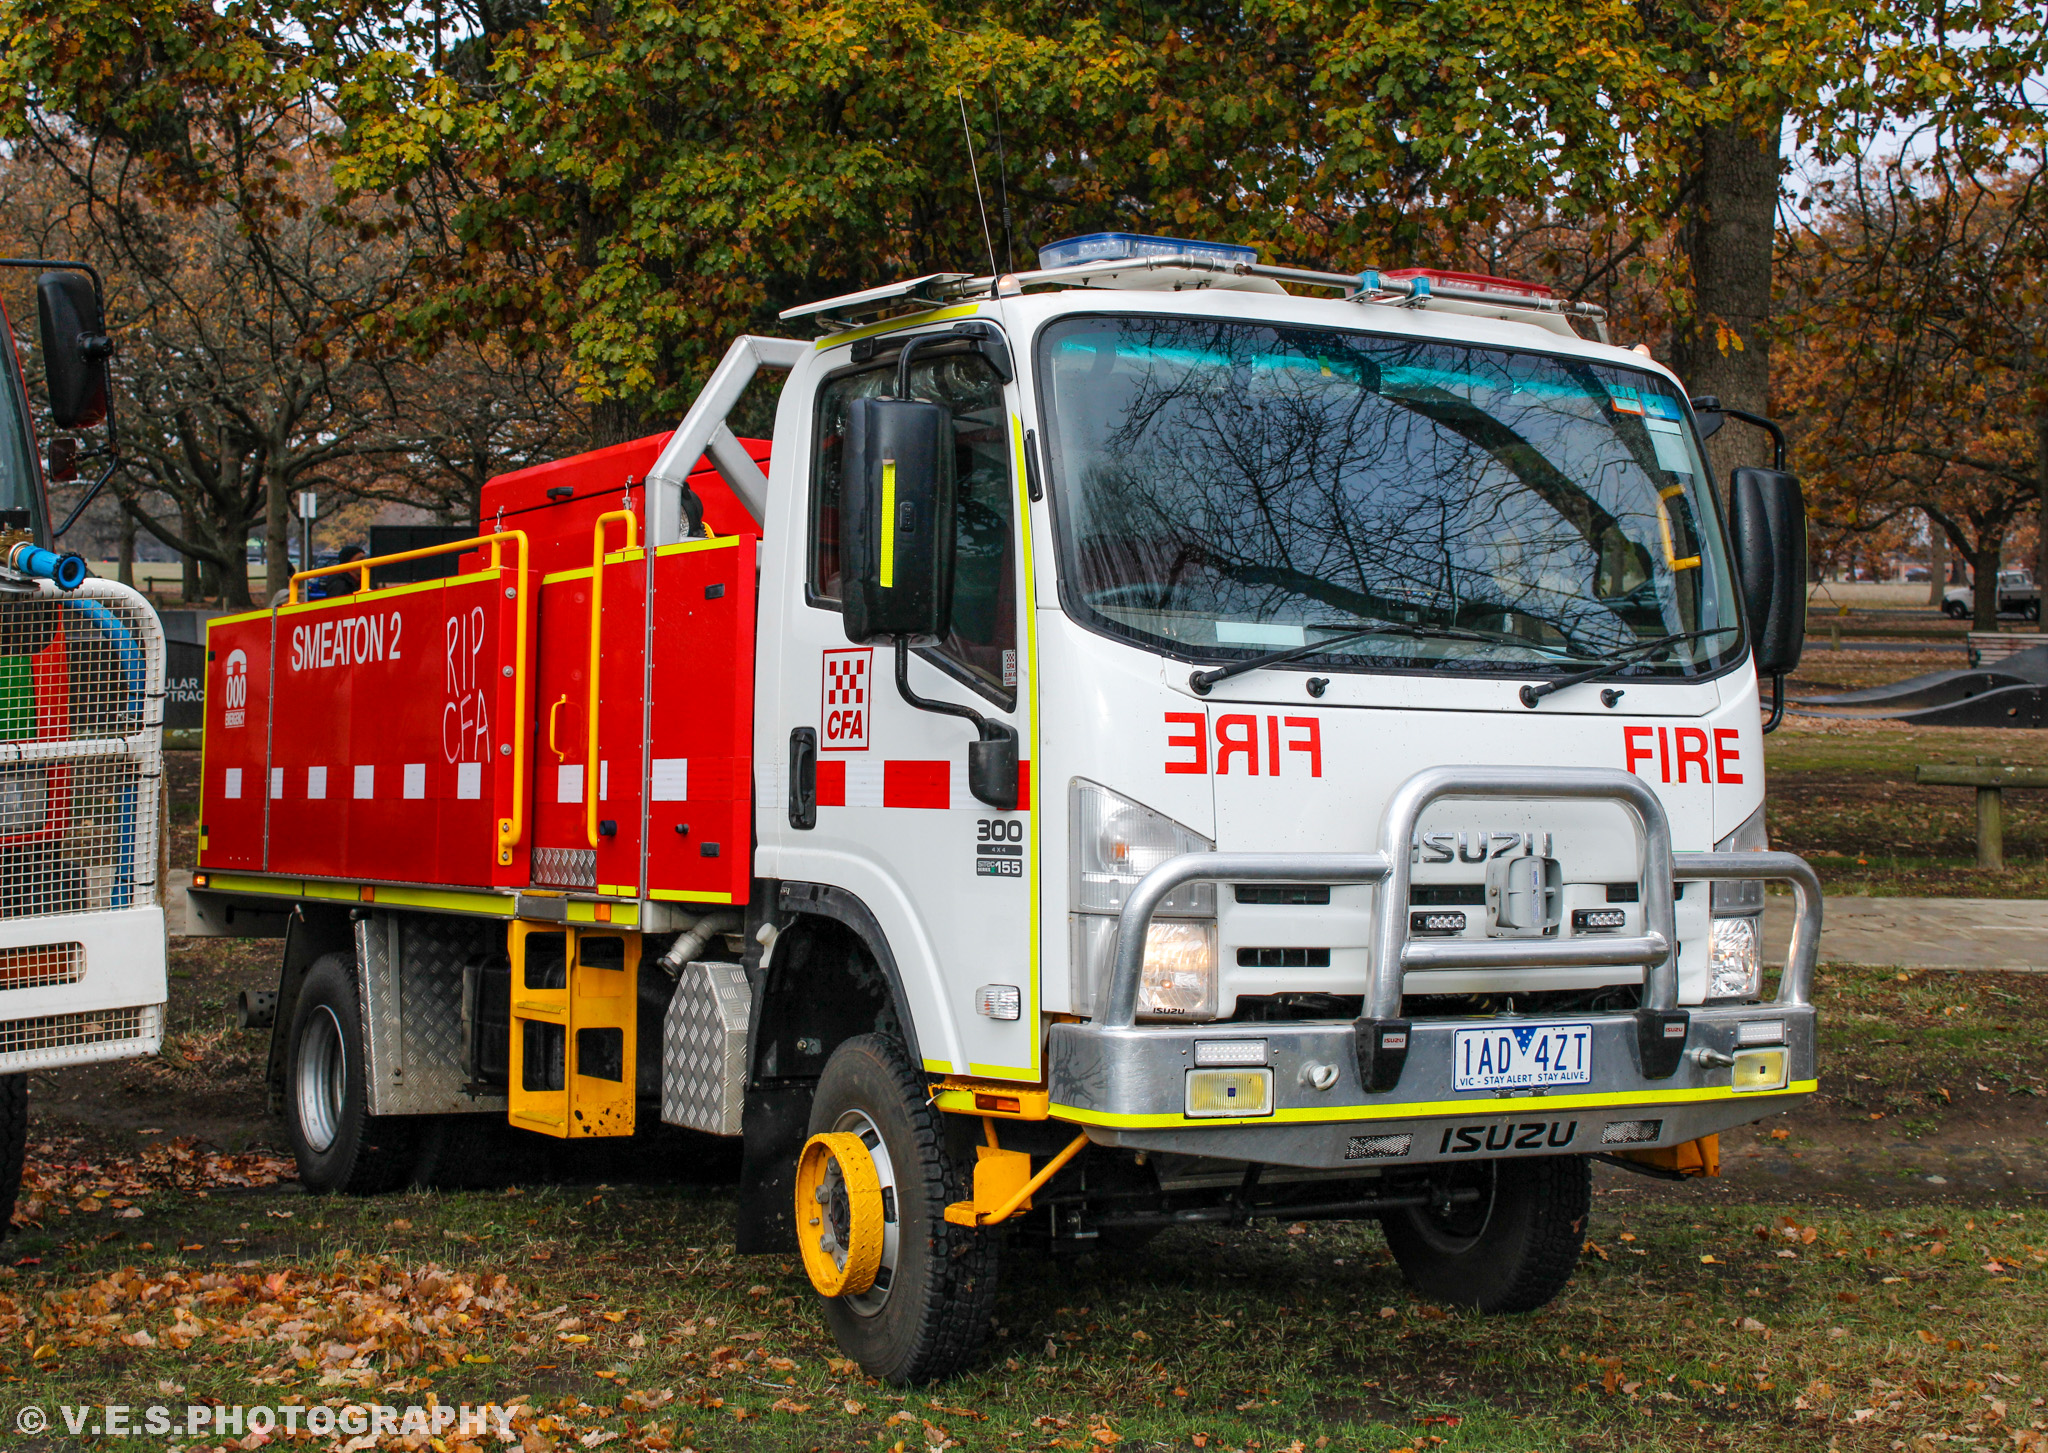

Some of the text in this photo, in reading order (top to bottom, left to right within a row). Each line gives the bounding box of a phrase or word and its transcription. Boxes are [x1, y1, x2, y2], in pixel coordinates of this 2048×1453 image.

[291, 611, 402, 672] SMEATON 2
[446, 606, 485, 698] RIP
[226, 674, 246, 709] 000
[443, 689, 491, 765] CFA
[827, 709, 863, 740] CFA
[1623, 726, 1744, 784] FIRE
[976, 818, 1023, 843] 300
[1412, 832, 1552, 863] ISUZU
[995, 860, 1021, 874] 155
[1152, 1007, 1185, 1015] ISUZU
[1464, 1033, 1587, 1076] 1AD 4ZT
[1459, 1077, 1474, 1087] VIC
[1484, 1075, 1505, 1085] STAY
[1506, 1074, 1533, 1083] ALERT
[1537, 1072, 1559, 1082] STAY
[1560, 1071, 1585, 1081] ALIVE
[1439, 1120, 1578, 1154] ISUZU
